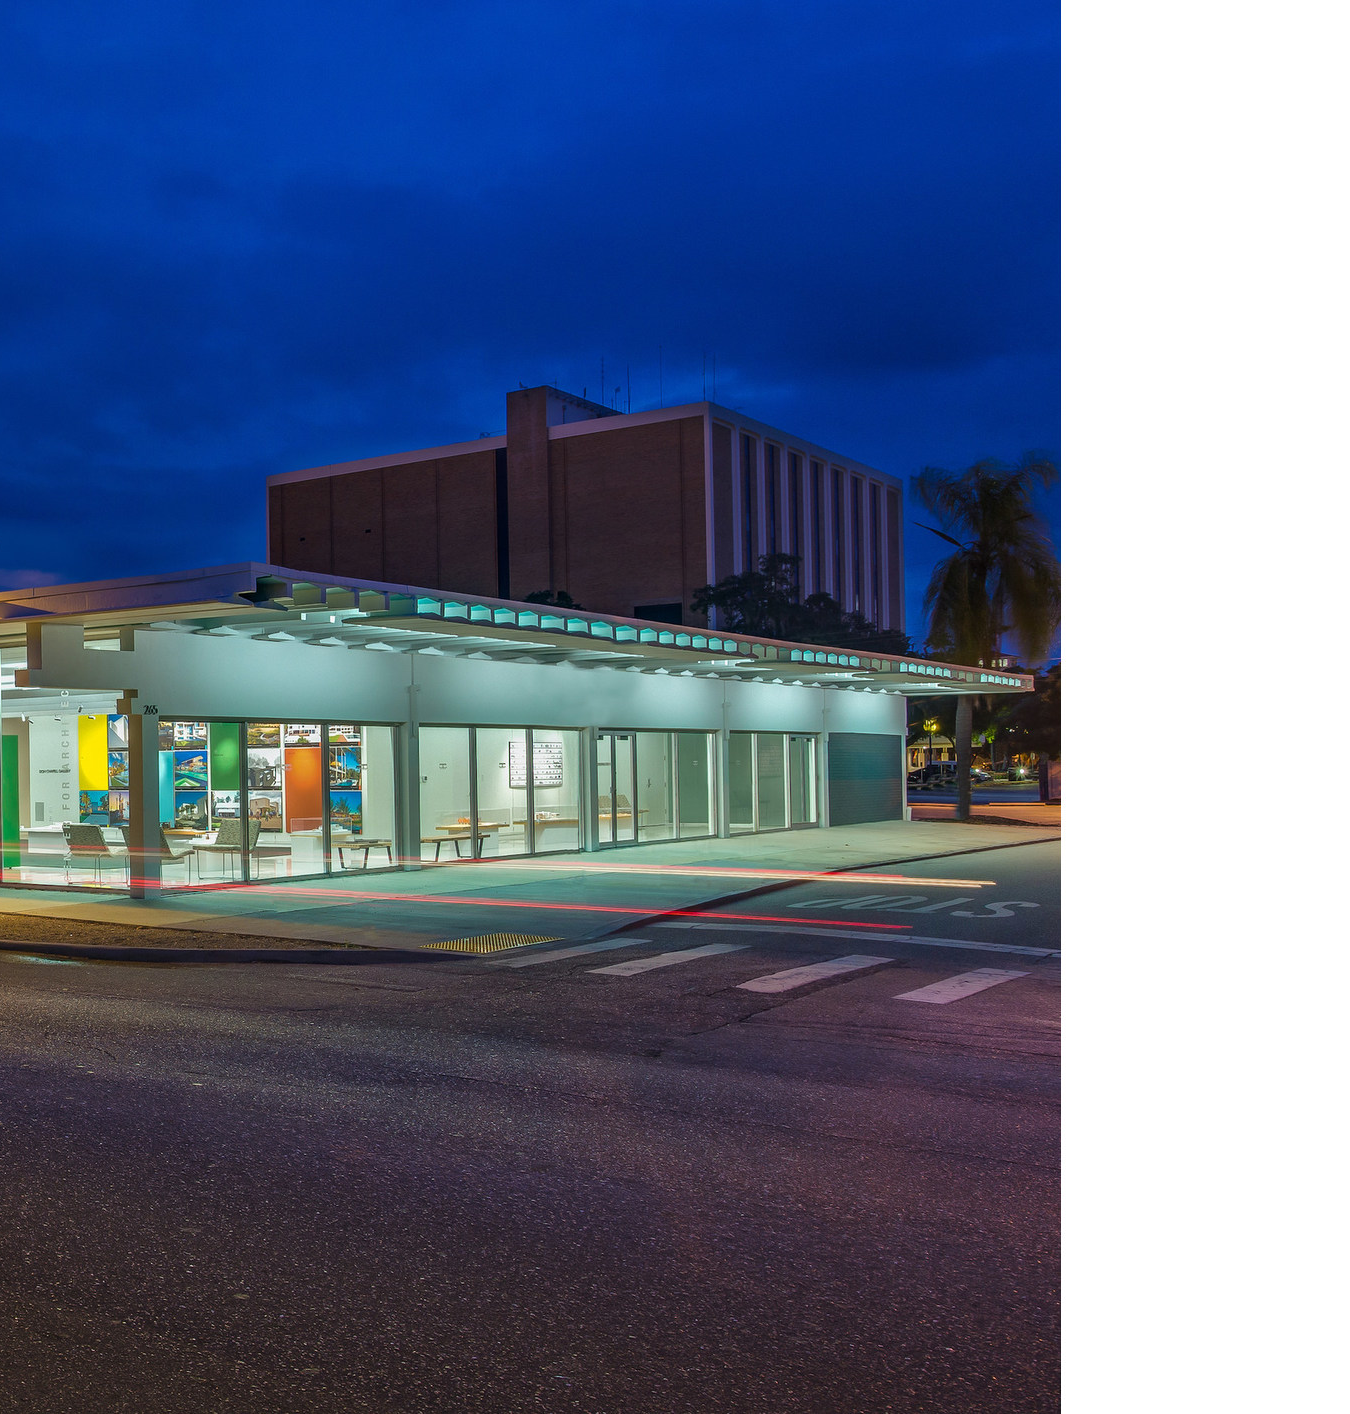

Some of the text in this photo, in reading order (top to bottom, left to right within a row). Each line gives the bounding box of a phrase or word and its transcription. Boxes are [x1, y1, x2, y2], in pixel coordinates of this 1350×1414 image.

[143, 704, 158, 715] 265
[62, 782, 70, 810] FOR
[786, 894, 1041, 918] STOP
